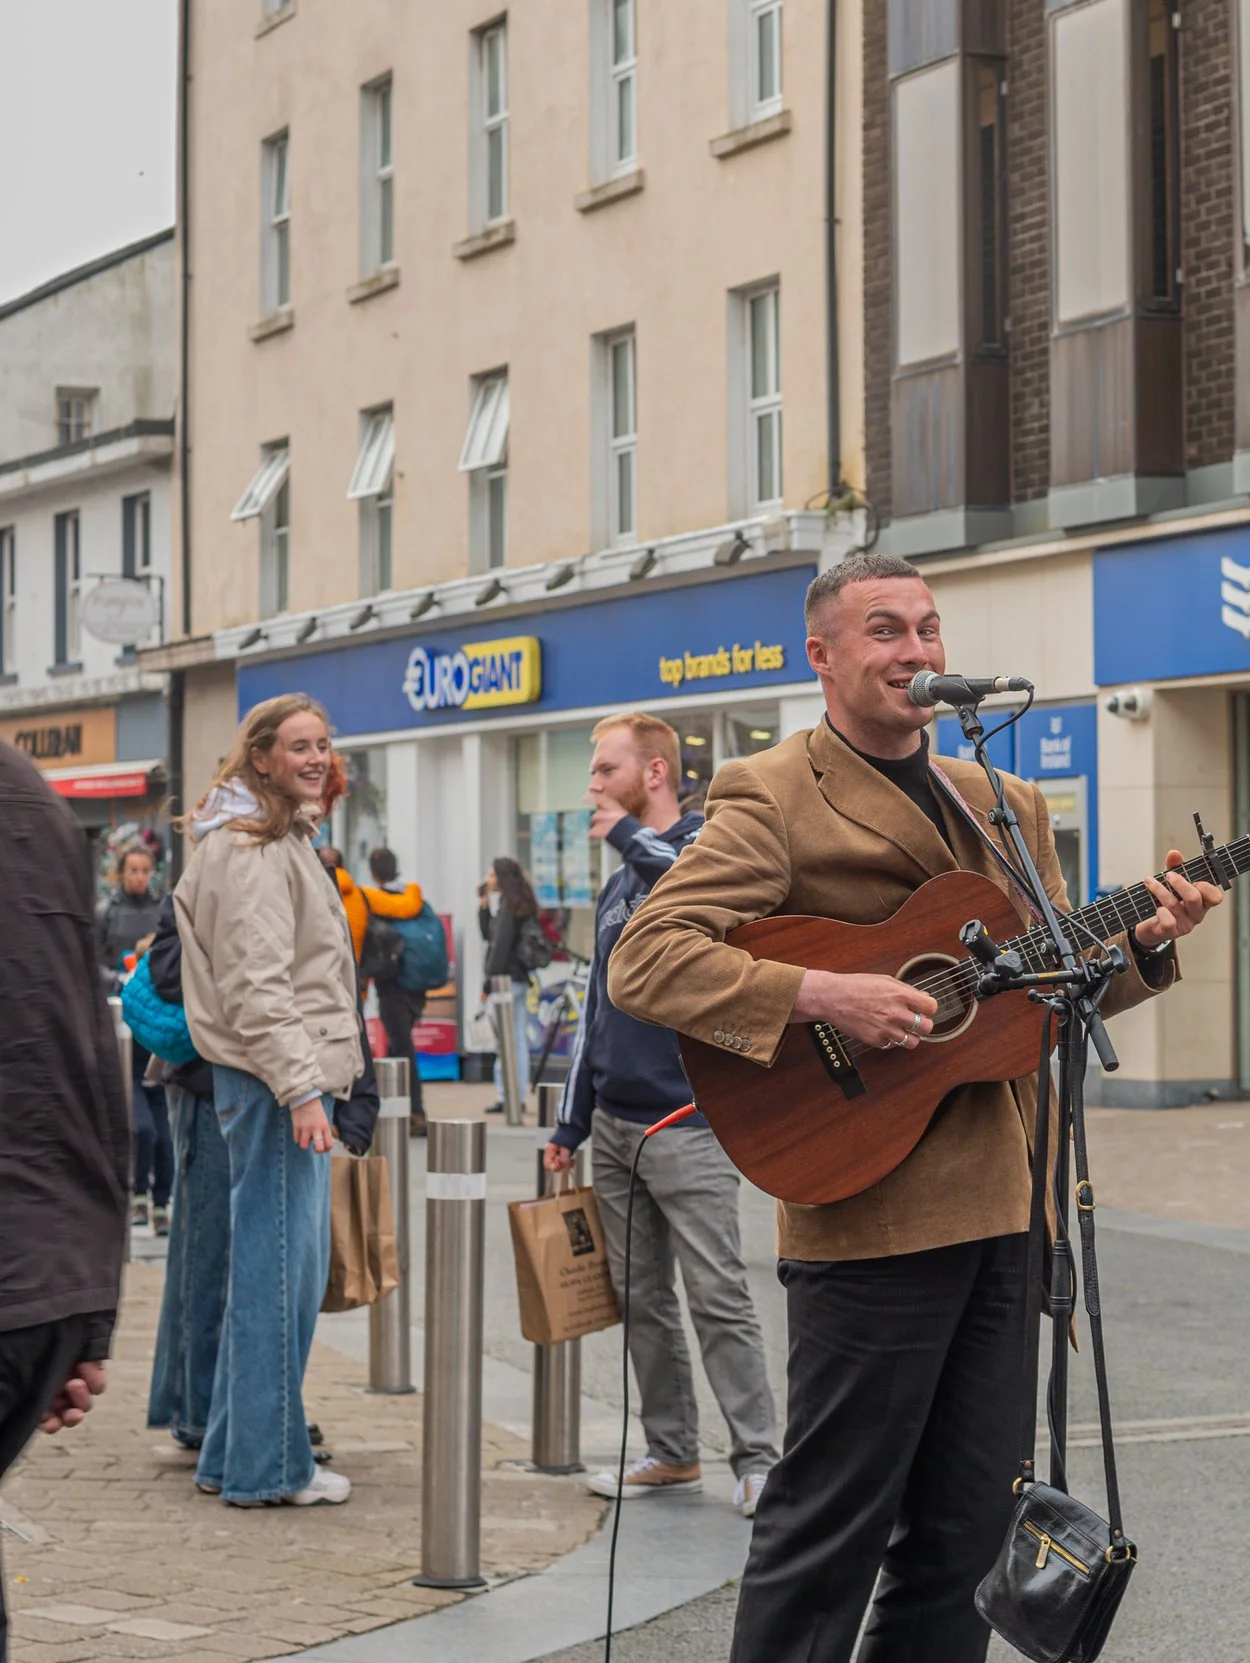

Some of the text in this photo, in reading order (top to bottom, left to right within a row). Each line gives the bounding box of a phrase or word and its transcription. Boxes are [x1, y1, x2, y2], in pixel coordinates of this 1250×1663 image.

[659, 640, 784, 688] top brands for less
